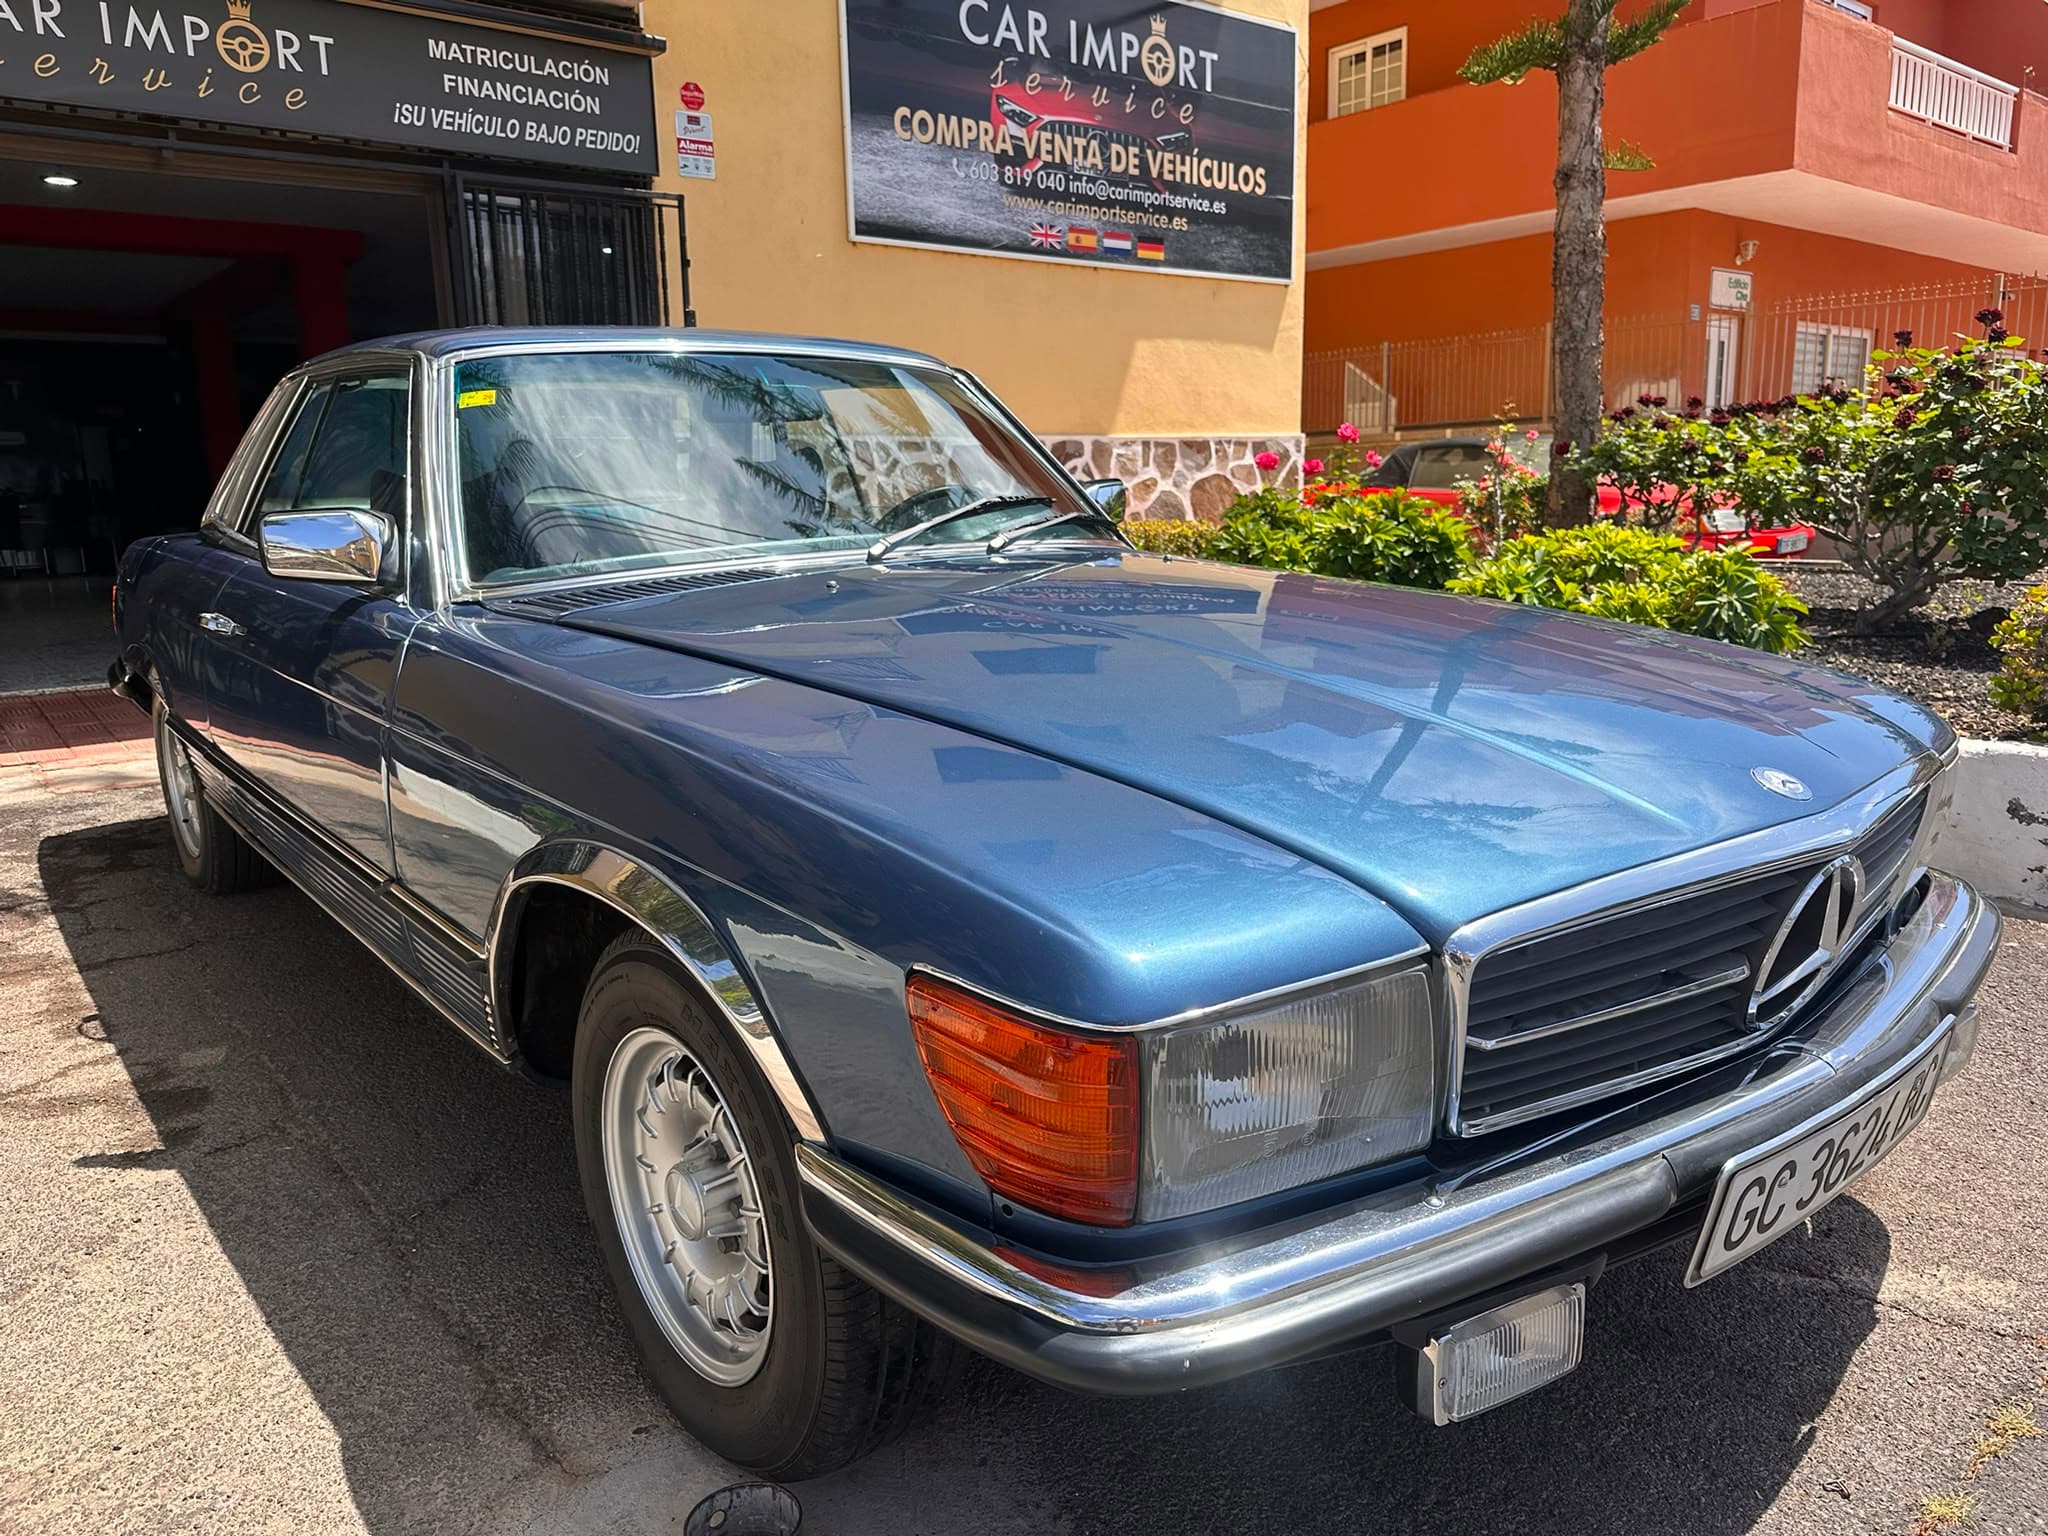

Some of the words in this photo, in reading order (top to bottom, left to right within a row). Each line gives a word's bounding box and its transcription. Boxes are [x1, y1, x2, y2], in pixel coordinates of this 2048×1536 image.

[99, 0, 335, 76] IMPORT
[428, 38, 610, 86] MATRICULACIÓN
[959, 0, 1051, 59] CAR
[1069, 19, 1219, 93] IMPORT
[0, 53, 307, 110] ervice
[443, 74, 601, 115] FINANCIACIÓN
[990, 57, 1195, 125] service
[394, 103, 426, 128] ¡SU
[431, 108, 521, 140] VEHÍCULO
[525, 121, 571, 147] BAJO
[575, 127, 641, 154] PEDIDO!
[679, 139, 713, 153] Alarma
[893, 106, 1015, 157] COMPRA
[1022, 128, 1102, 171] VENTA
[1111, 142, 1141, 176] DE
[1146, 149, 1267, 196] VEHÍCULOS
[970, 160, 999, 182] 603
[1004, 166, 1031, 187] 819
[1037, 171, 1065, 193] 040
[1069, 175, 1227, 215] info@carimportservice.es
[1003, 193, 1188, 231] www.carimportservice.es
[1723, 1159, 1798, 1251] GC
[1795, 1090, 1900, 1211] 3624
